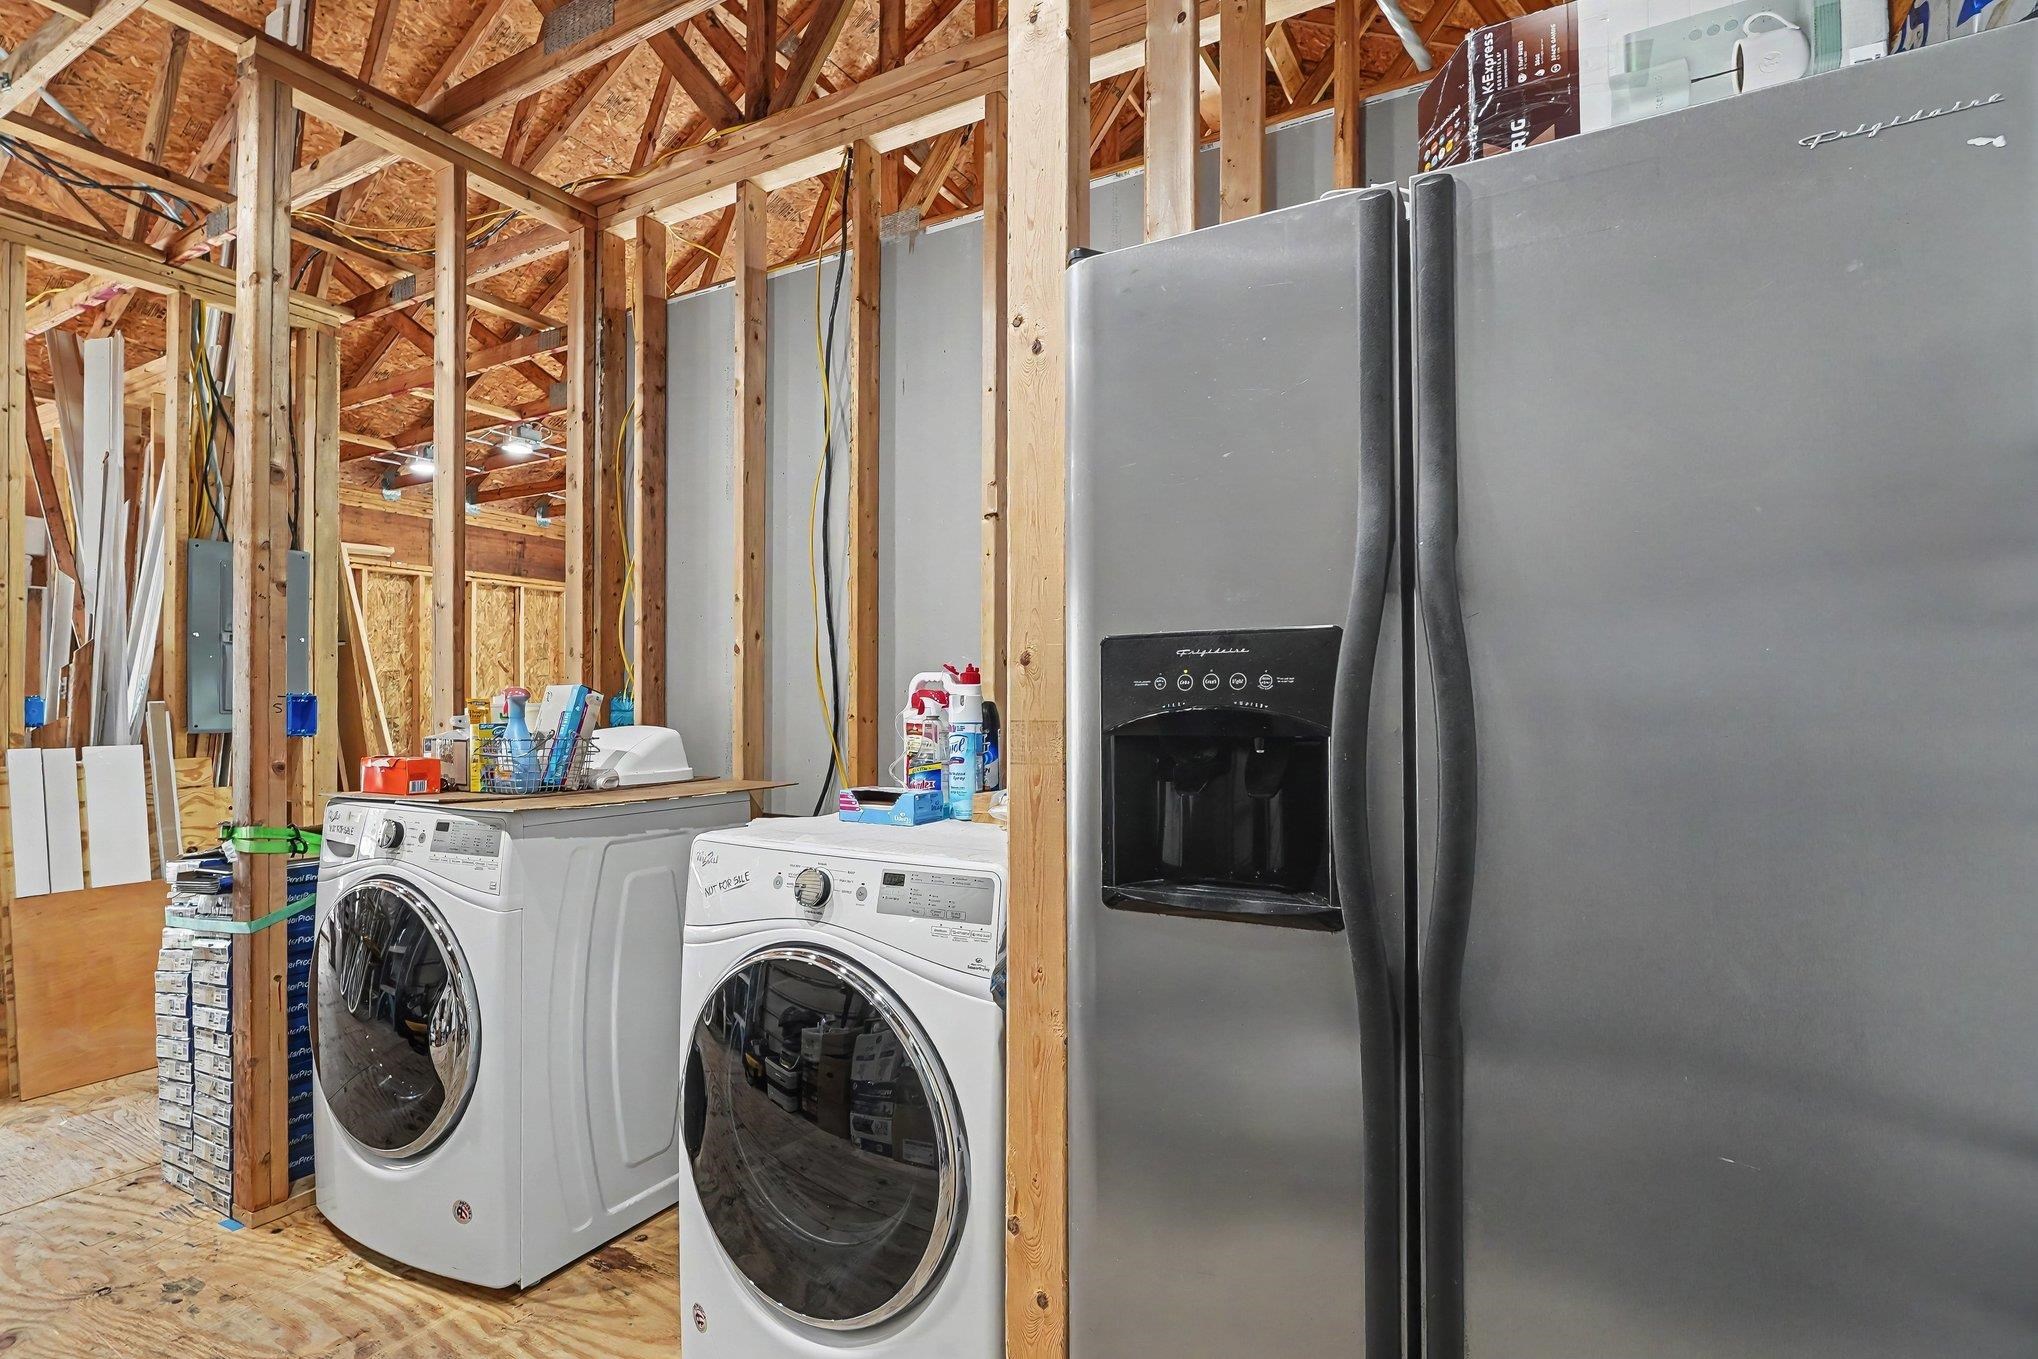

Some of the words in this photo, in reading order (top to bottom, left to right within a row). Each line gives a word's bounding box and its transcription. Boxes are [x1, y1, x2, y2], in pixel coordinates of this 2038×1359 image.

[1798, 93, 2006, 150] Frigidaire
[1175, 648, 1250, 657] Frigidaire
[704, 885, 717, 897] NOT
[719, 878, 732, 890] FOR
